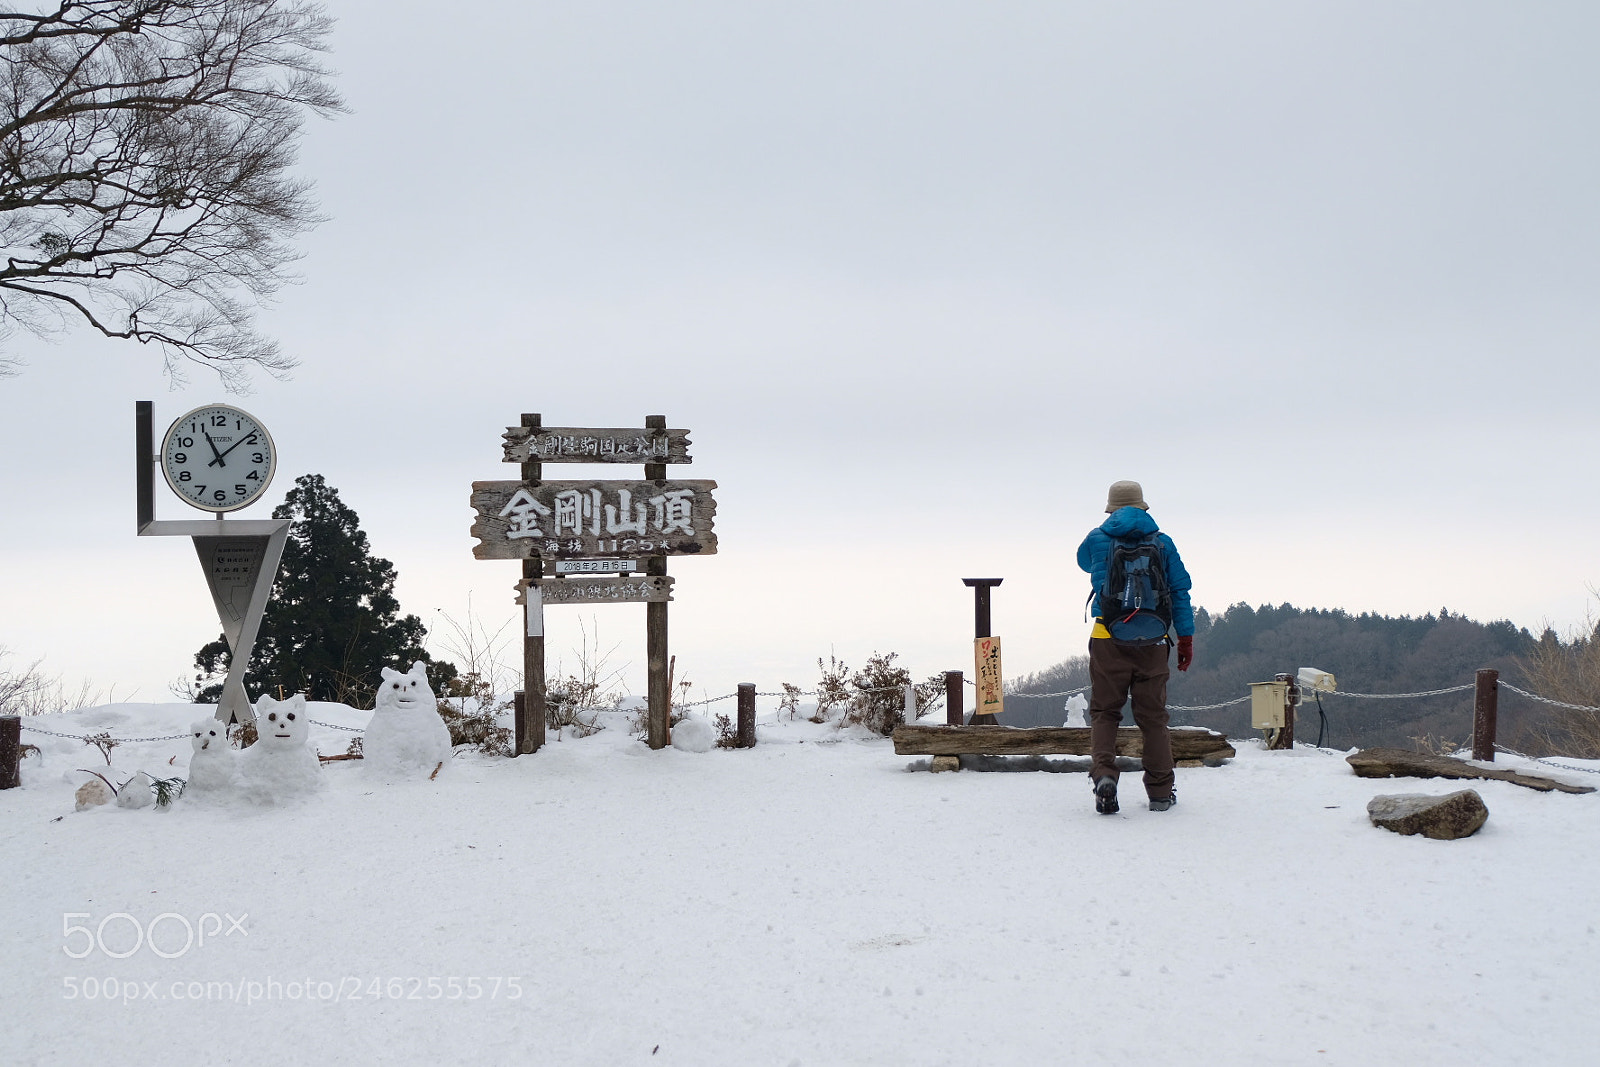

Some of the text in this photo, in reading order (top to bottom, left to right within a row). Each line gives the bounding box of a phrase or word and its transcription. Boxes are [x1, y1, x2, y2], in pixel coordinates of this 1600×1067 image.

[211, 415, 226, 427] 12
[236, 420, 241, 431] 1
[191, 422, 205, 433] 11
[177, 437, 194, 448] 10
[246, 434, 258, 445] 2
[174, 453, 187, 464] 9
[251, 453, 264, 464] 3
[179, 471, 192, 482] 8
[245, 470, 260, 481] 4
[194, 485, 207, 496] 7
[213, 490, 226, 501] 6
[234, 484, 247, 496] 5
[498, 487, 696, 539] 金剛山頂
